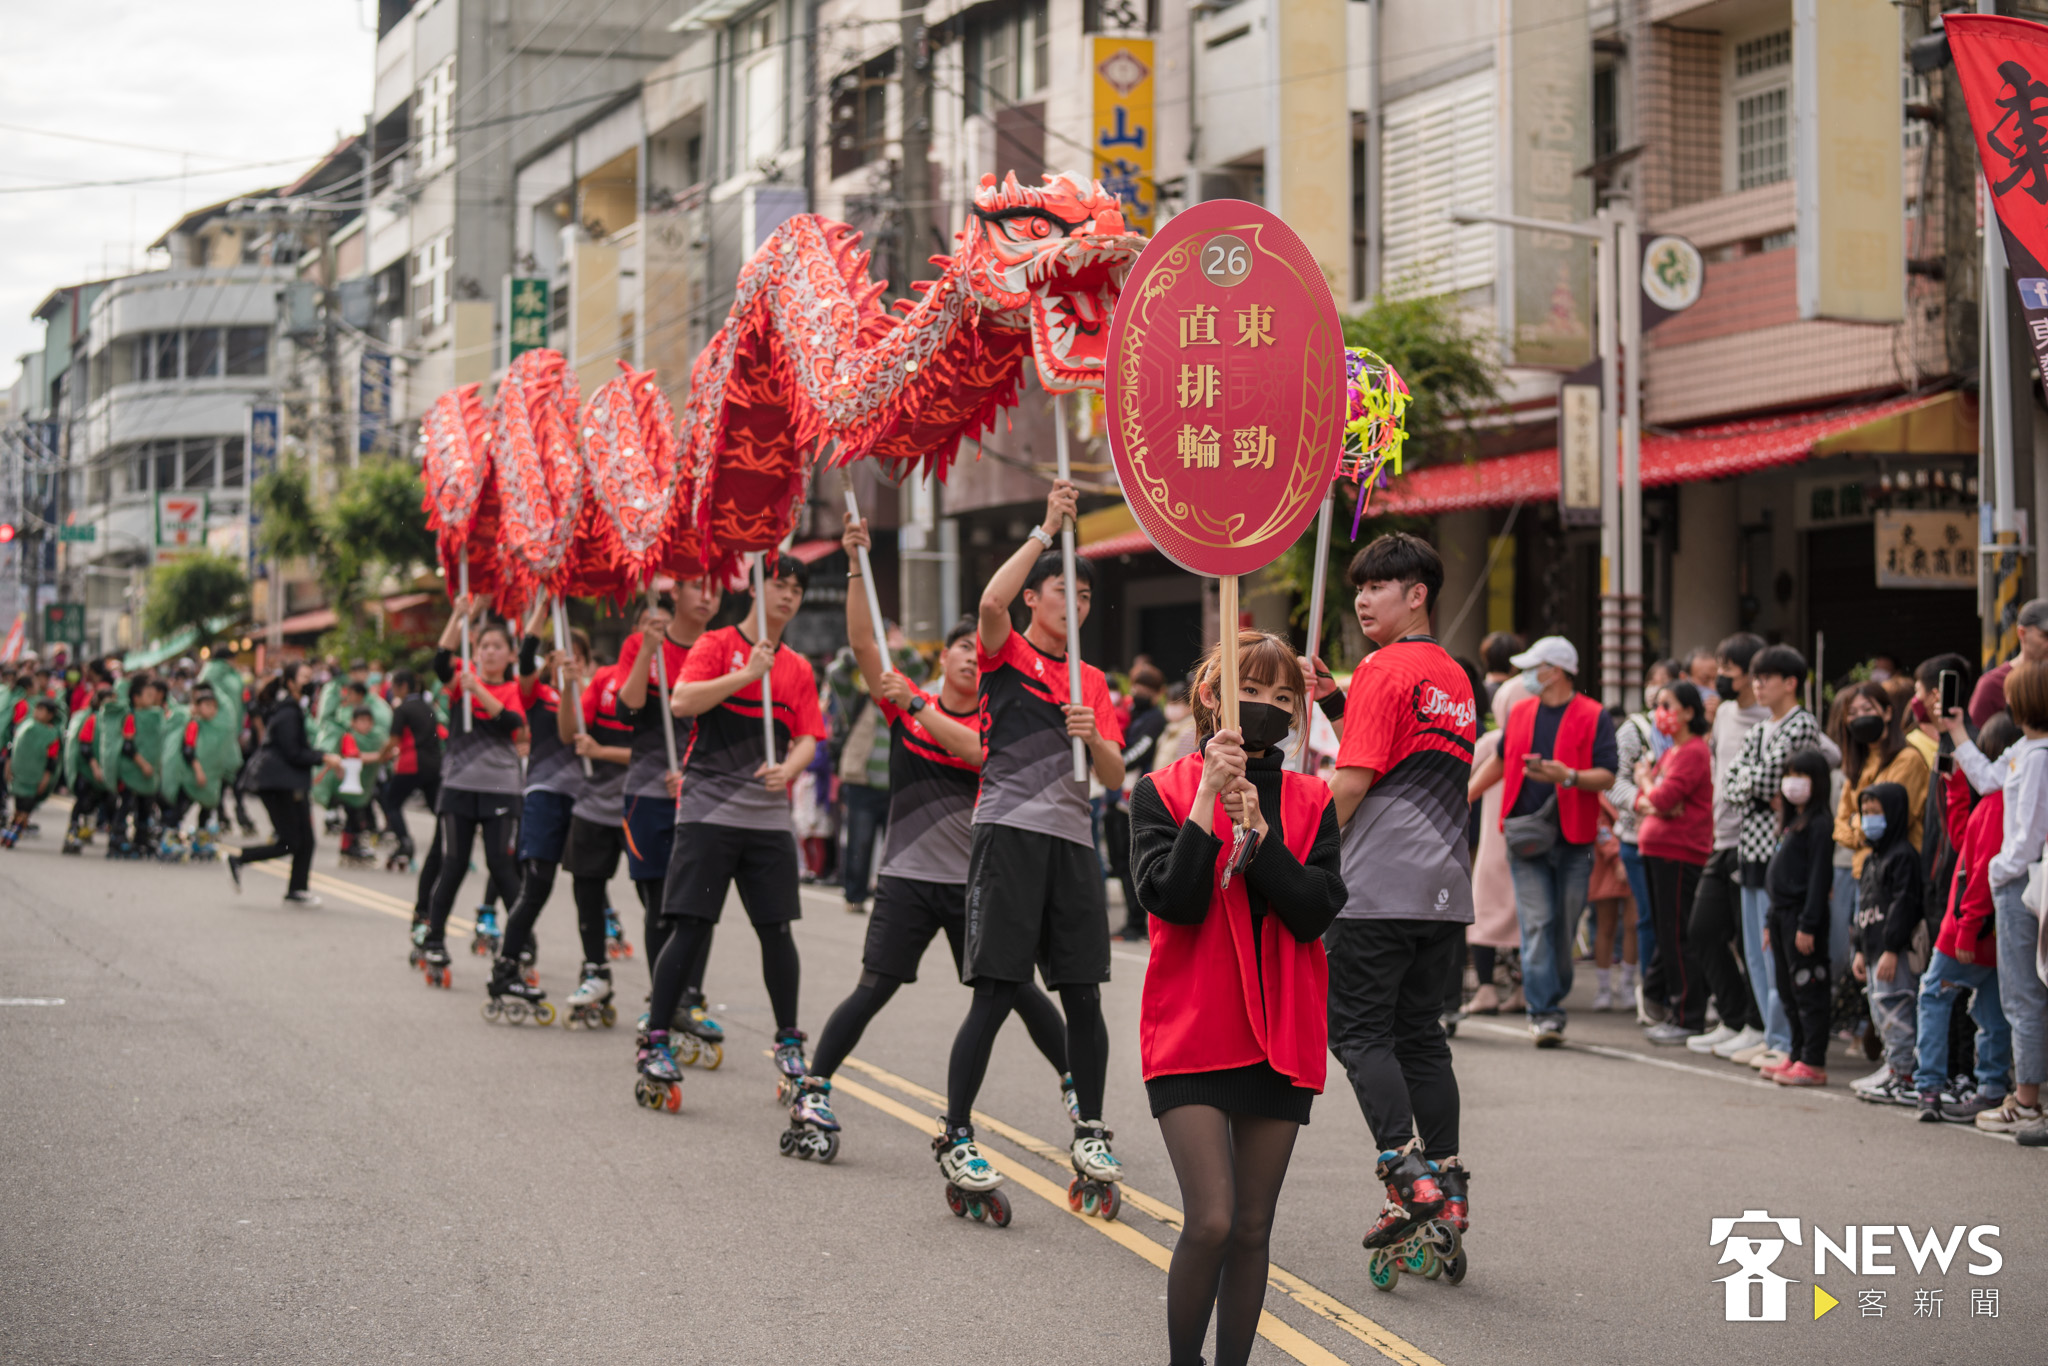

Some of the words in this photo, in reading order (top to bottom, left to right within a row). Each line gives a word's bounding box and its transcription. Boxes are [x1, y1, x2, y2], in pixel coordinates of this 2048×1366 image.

[1206, 246, 1247, 275] 26
[1176, 304, 1221, 470] 直排輪
